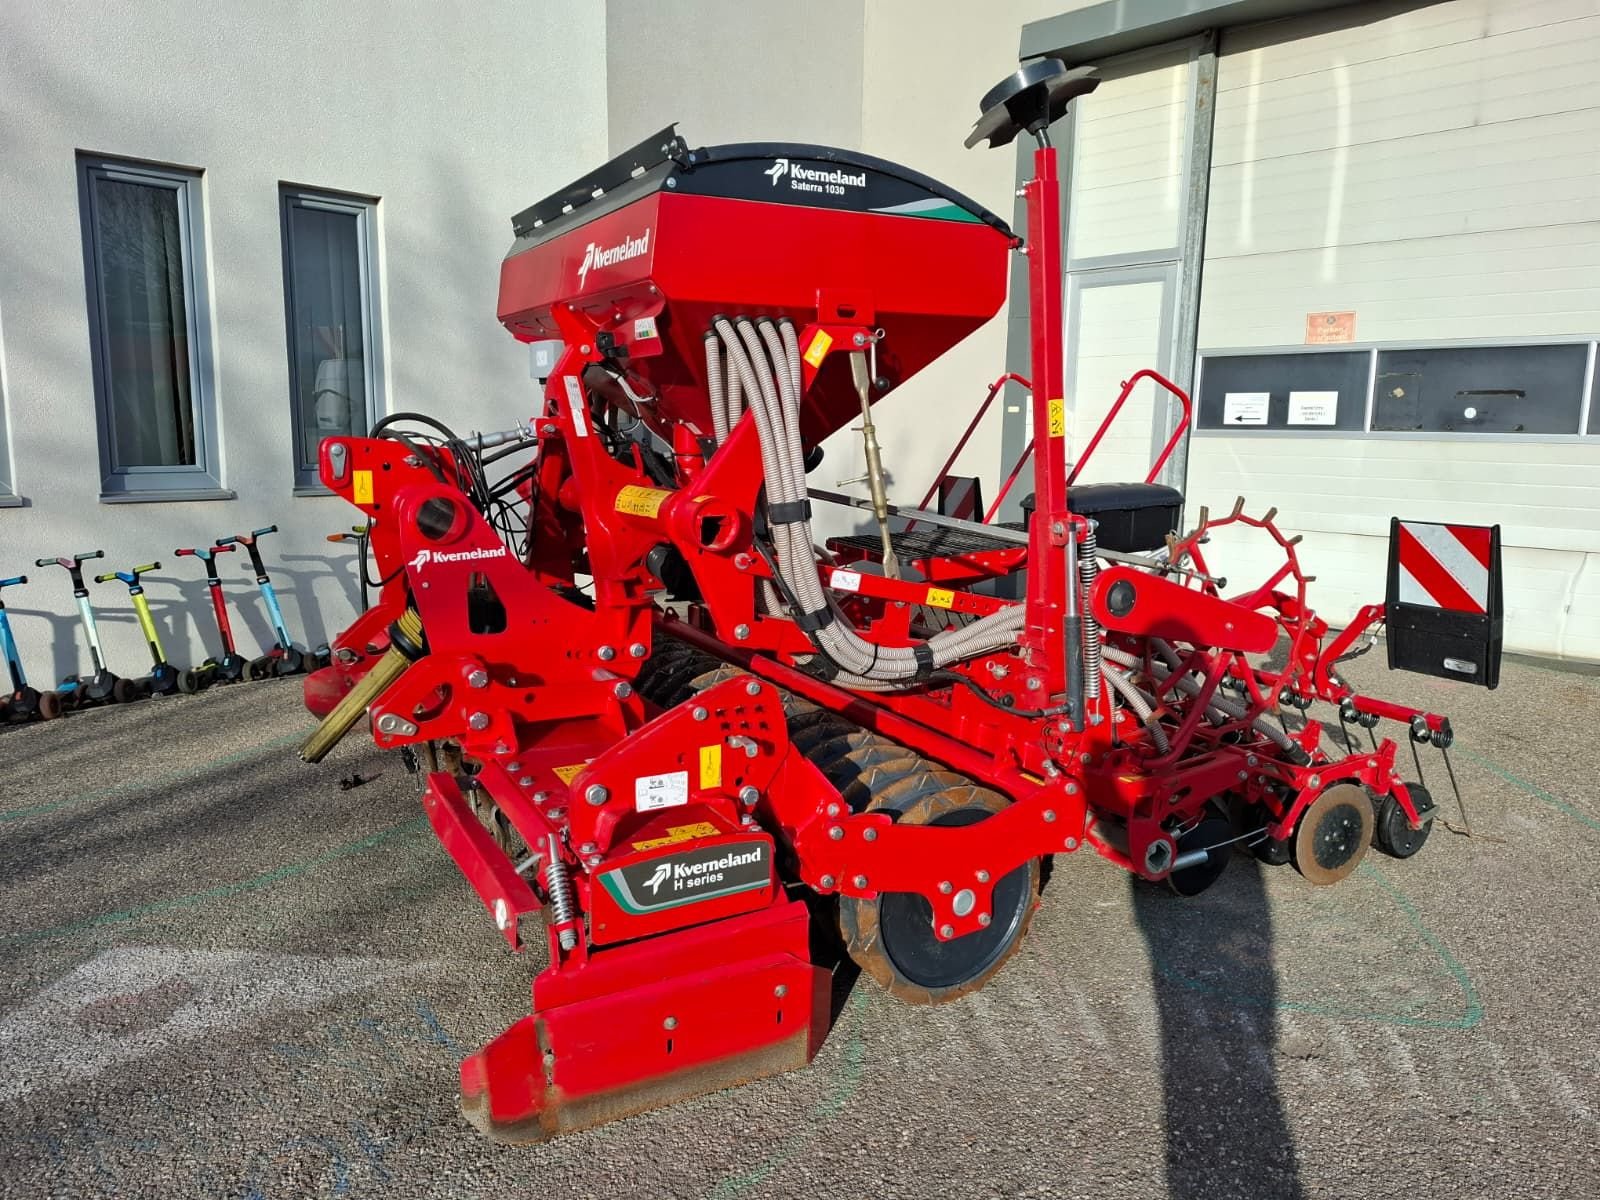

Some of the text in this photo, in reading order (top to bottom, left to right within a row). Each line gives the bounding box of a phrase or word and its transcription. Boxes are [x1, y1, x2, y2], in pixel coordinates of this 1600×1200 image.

[791, 163, 866, 187] Kverneland
[791, 180, 845, 195] Saterra 1030
[593, 227, 650, 270] Kverneland
[432, 545, 506, 563] Kverneland
[673, 847, 761, 879] Kverneland
[674, 872, 724, 891] H series
